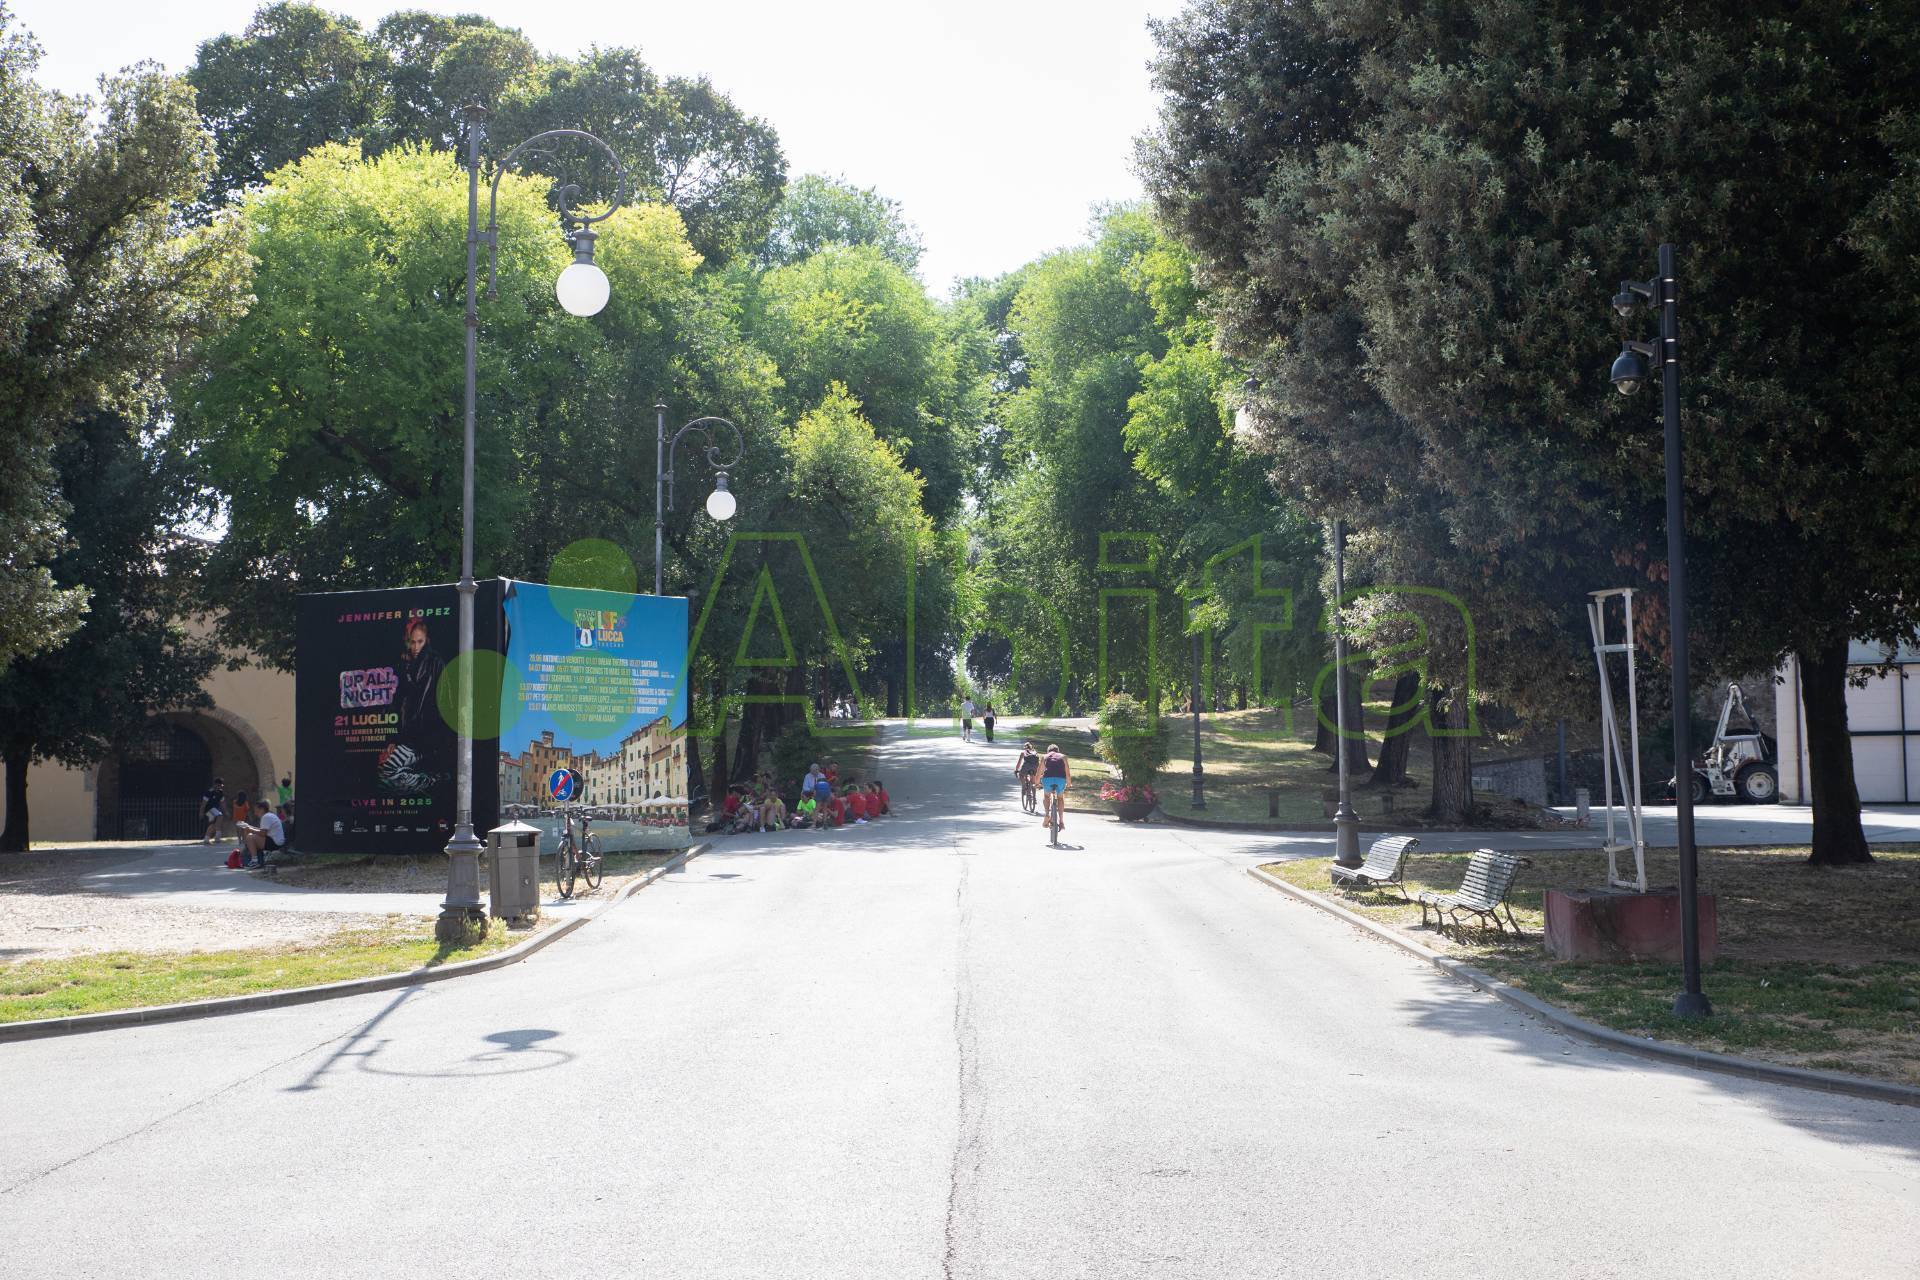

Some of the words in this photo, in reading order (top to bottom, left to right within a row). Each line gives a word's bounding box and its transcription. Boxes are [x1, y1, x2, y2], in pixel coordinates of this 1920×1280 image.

[338, 611, 402, 623] JENNIFER
[408, 607, 451, 618] LOPEZ
[597, 630, 624, 643] LUCCA
[343, 673, 365, 688] UP
[366, 671, 394, 686] ALL
[343, 687, 391, 703] NIGHT
[335, 715, 348, 726] 21
[352, 713, 399, 726] LUGLIO
[352, 799, 377, 807] LIVE
[382, 798, 395, 806] IN
[400, 798, 433, 806] 2025
